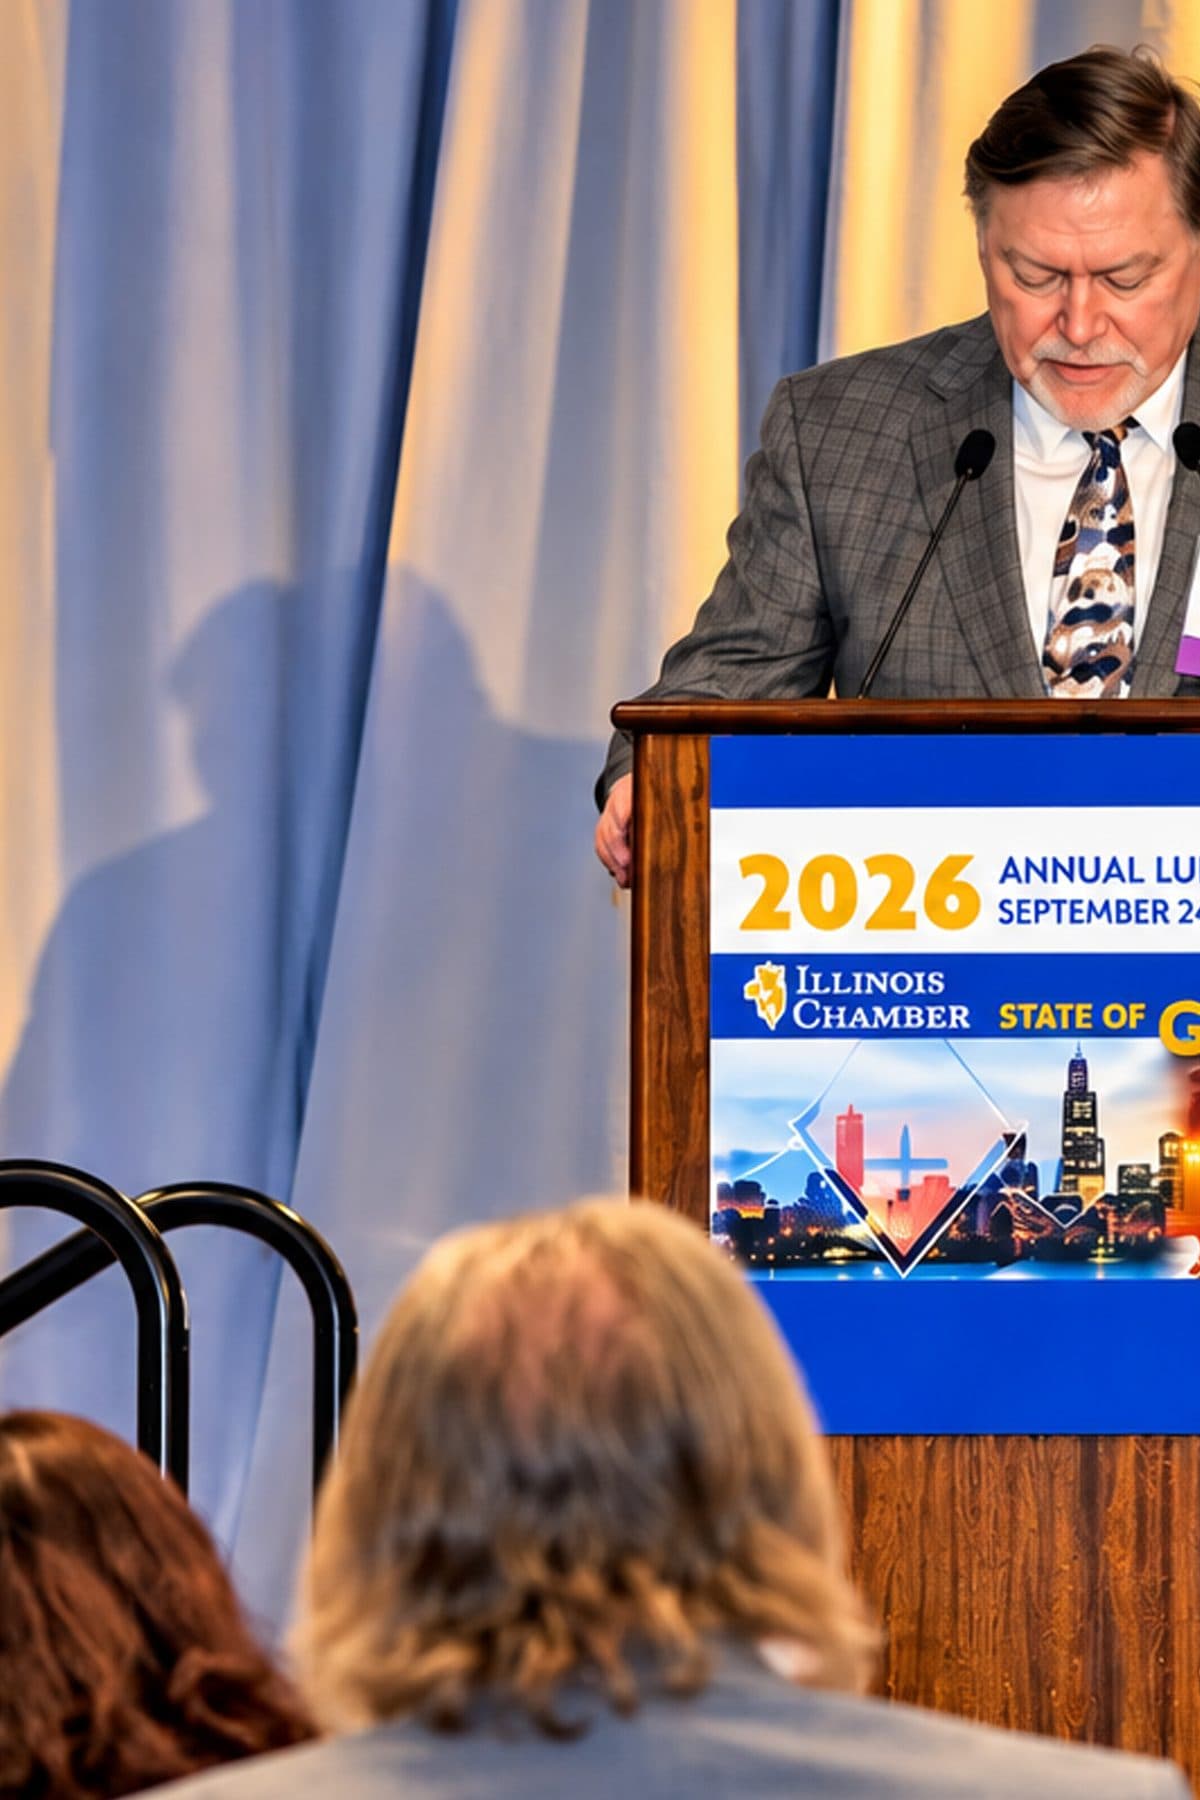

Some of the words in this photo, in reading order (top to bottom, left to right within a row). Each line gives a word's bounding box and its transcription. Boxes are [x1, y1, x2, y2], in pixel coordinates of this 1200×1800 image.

[998, 856, 1145, 884] ANNUAL
[738, 853, 981, 932] 2026
[998, 899, 1169, 925] SEPTEMBER
[795, 964, 945, 995] ILLINOIS
[792, 998, 971, 1030] CHAMBER
[999, 1003, 1093, 1030] STATE
[1102, 1003, 1146, 1030] OF
